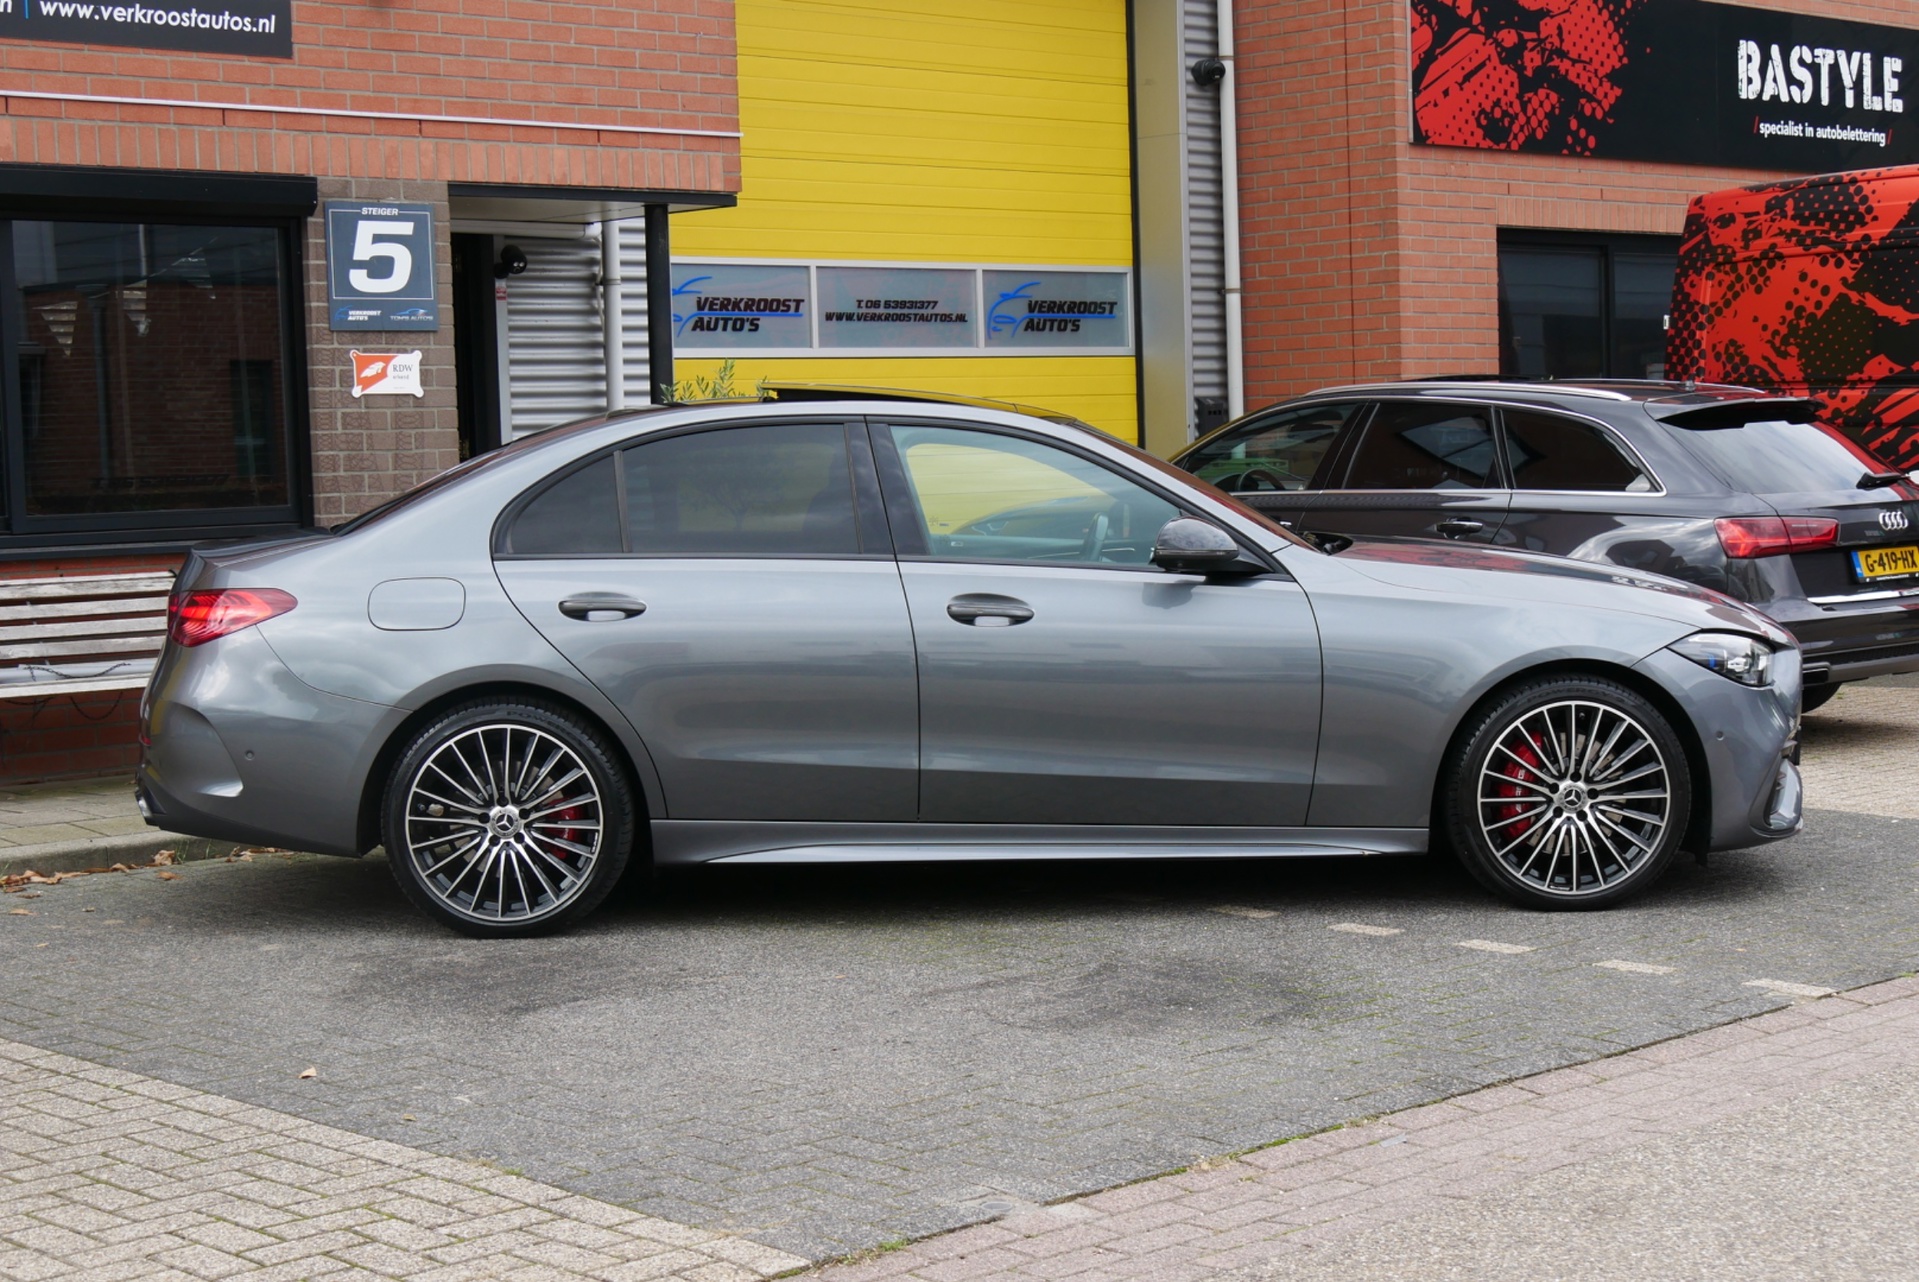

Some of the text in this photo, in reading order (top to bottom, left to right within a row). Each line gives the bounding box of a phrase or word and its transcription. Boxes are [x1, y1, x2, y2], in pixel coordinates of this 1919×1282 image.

[40, 0, 276, 34] www.verkroostautos.nl
[1738, 39, 1904, 113] BASTYLE
[1805, 122, 1814, 138] in
[361, 207, 399, 216] STEIGER
[349, 220, 414, 293] 5
[696, 296, 805, 313] VERKROOST
[865, 300, 881, 309] 06
[883, 300, 939, 310] 53931377
[1027, 300, 1118, 315] VERKROOST
[691, 316, 761, 332] AUTO'S
[825, 311, 968, 323] WWW.VERKROOSTAUTOS.NL
[1023, 318, 1082, 332] AUTO'S
[392, 364, 413, 372] RDW
[1865, 549, 1918, 573] G-419-HX
